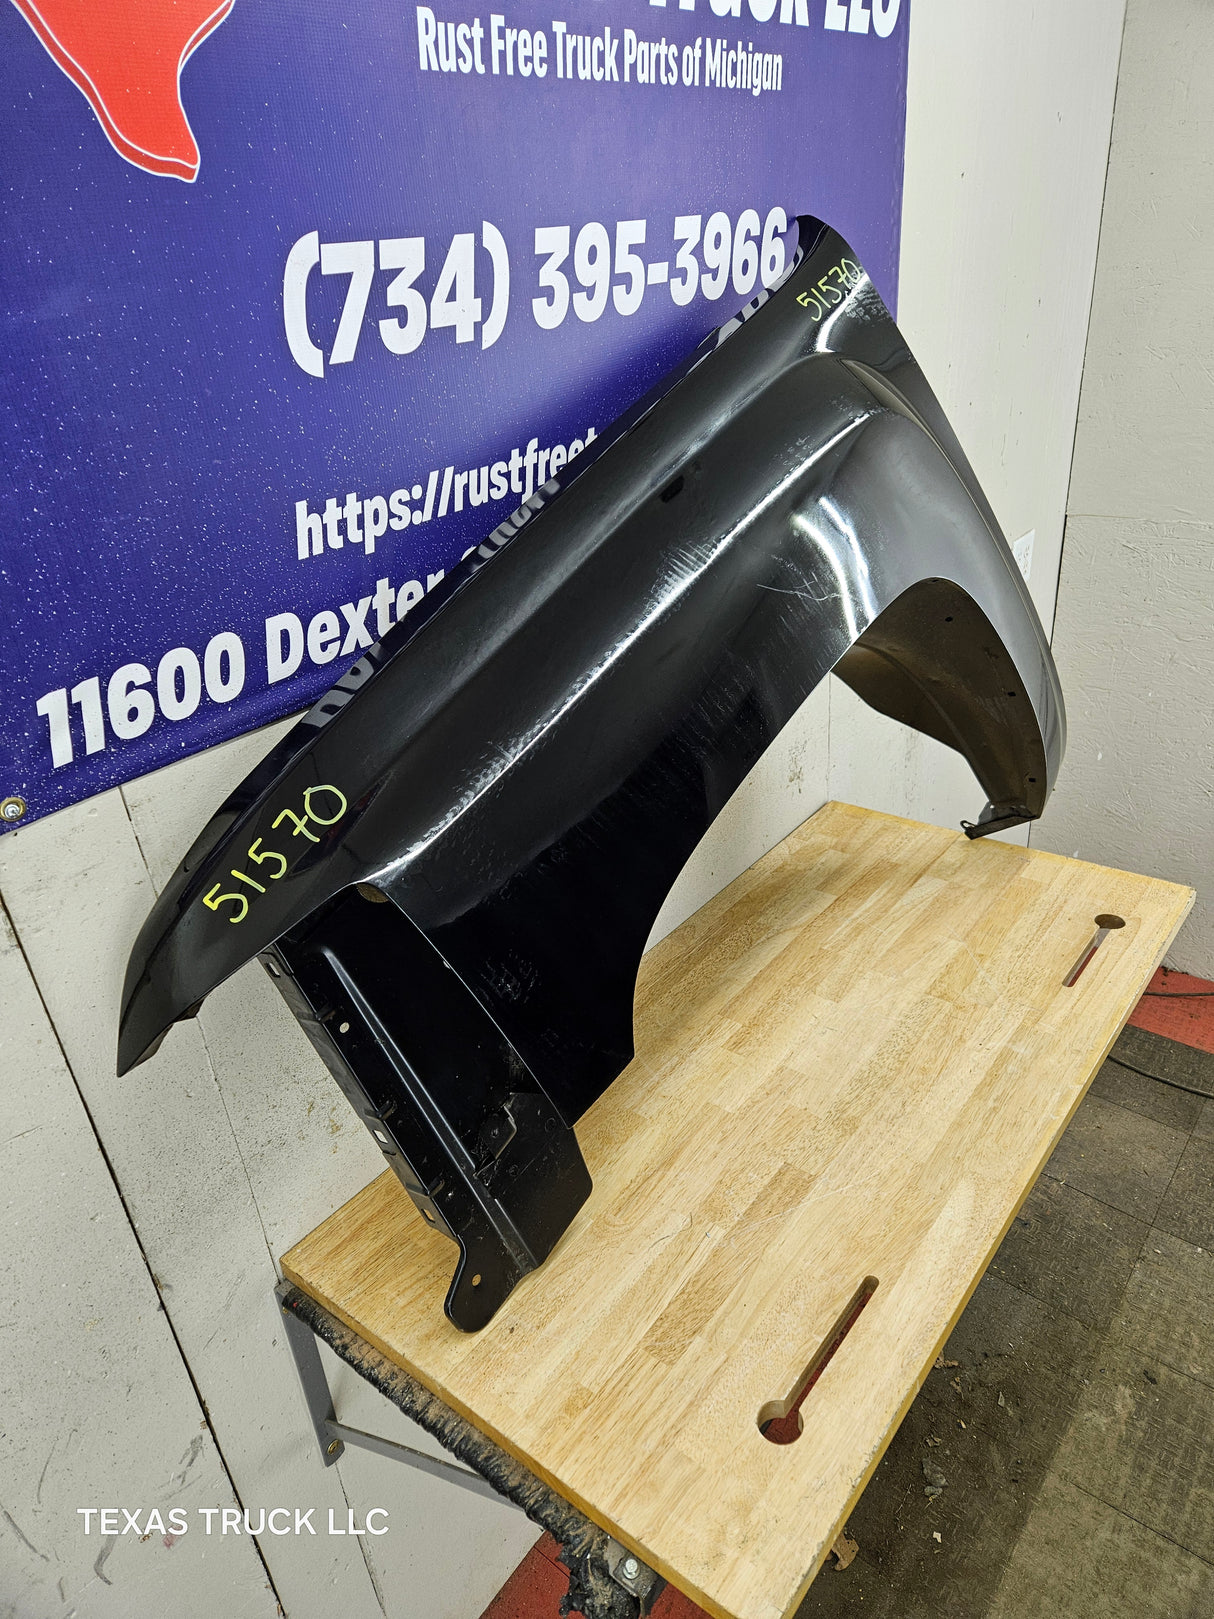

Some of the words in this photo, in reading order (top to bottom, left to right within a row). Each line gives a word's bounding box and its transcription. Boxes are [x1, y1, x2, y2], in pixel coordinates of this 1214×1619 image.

[417, 6, 486, 75] Rust
[491, 13, 548, 78] Free
[551, 20, 620, 82] Truck
[623, 28, 679, 86] Parts
[682, 36, 702, 87] of
[704, 37, 783, 97] Michigan
[283, 220, 510, 379] (734)
[531, 206, 788, 330] 395-3966
[796, 257, 861, 322] 51570
[36, 631, 246, 769] 11600
[202, 784, 348, 924] 51570
